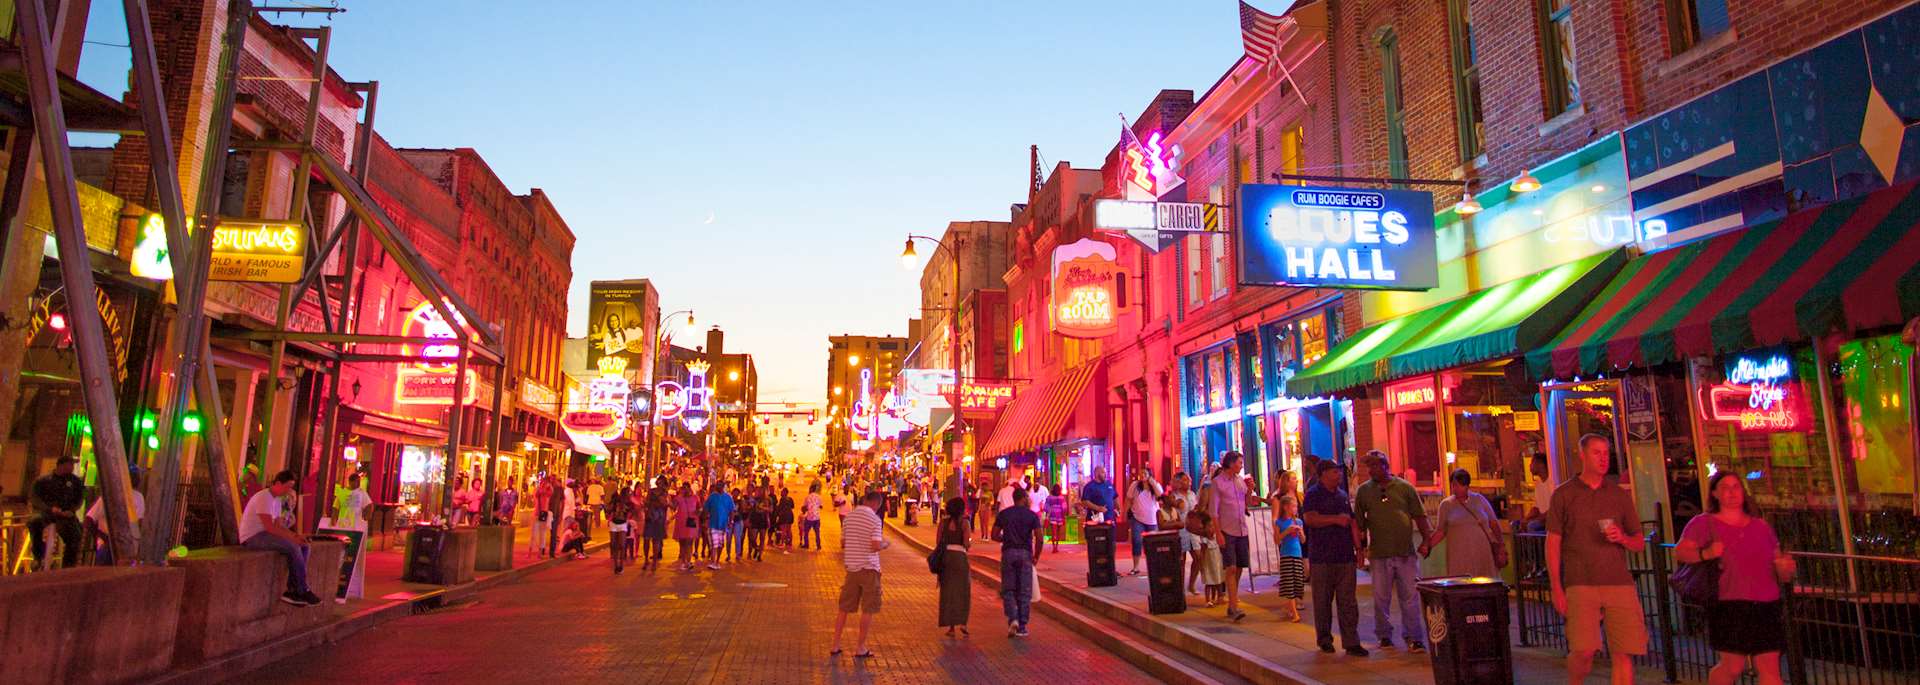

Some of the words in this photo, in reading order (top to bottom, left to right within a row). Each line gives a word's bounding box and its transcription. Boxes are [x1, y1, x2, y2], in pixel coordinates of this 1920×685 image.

[1297, 193, 1317, 205] RUM
[1318, 193, 1349, 206] BOOGIE
[1350, 195, 1379, 207] CAFE'S
[1159, 204, 1201, 229] CARGO
[1271, 209, 1409, 245] BLUES
[210, 257, 232, 266] RLD
[246, 258, 291, 269] FAMOUS
[1286, 246, 1396, 281] HALL
[213, 266, 242, 276] IRISH
[246, 268, 268, 277] BAR
[1074, 291, 1106, 304] TAP
[1061, 303, 1111, 321] ROOM
